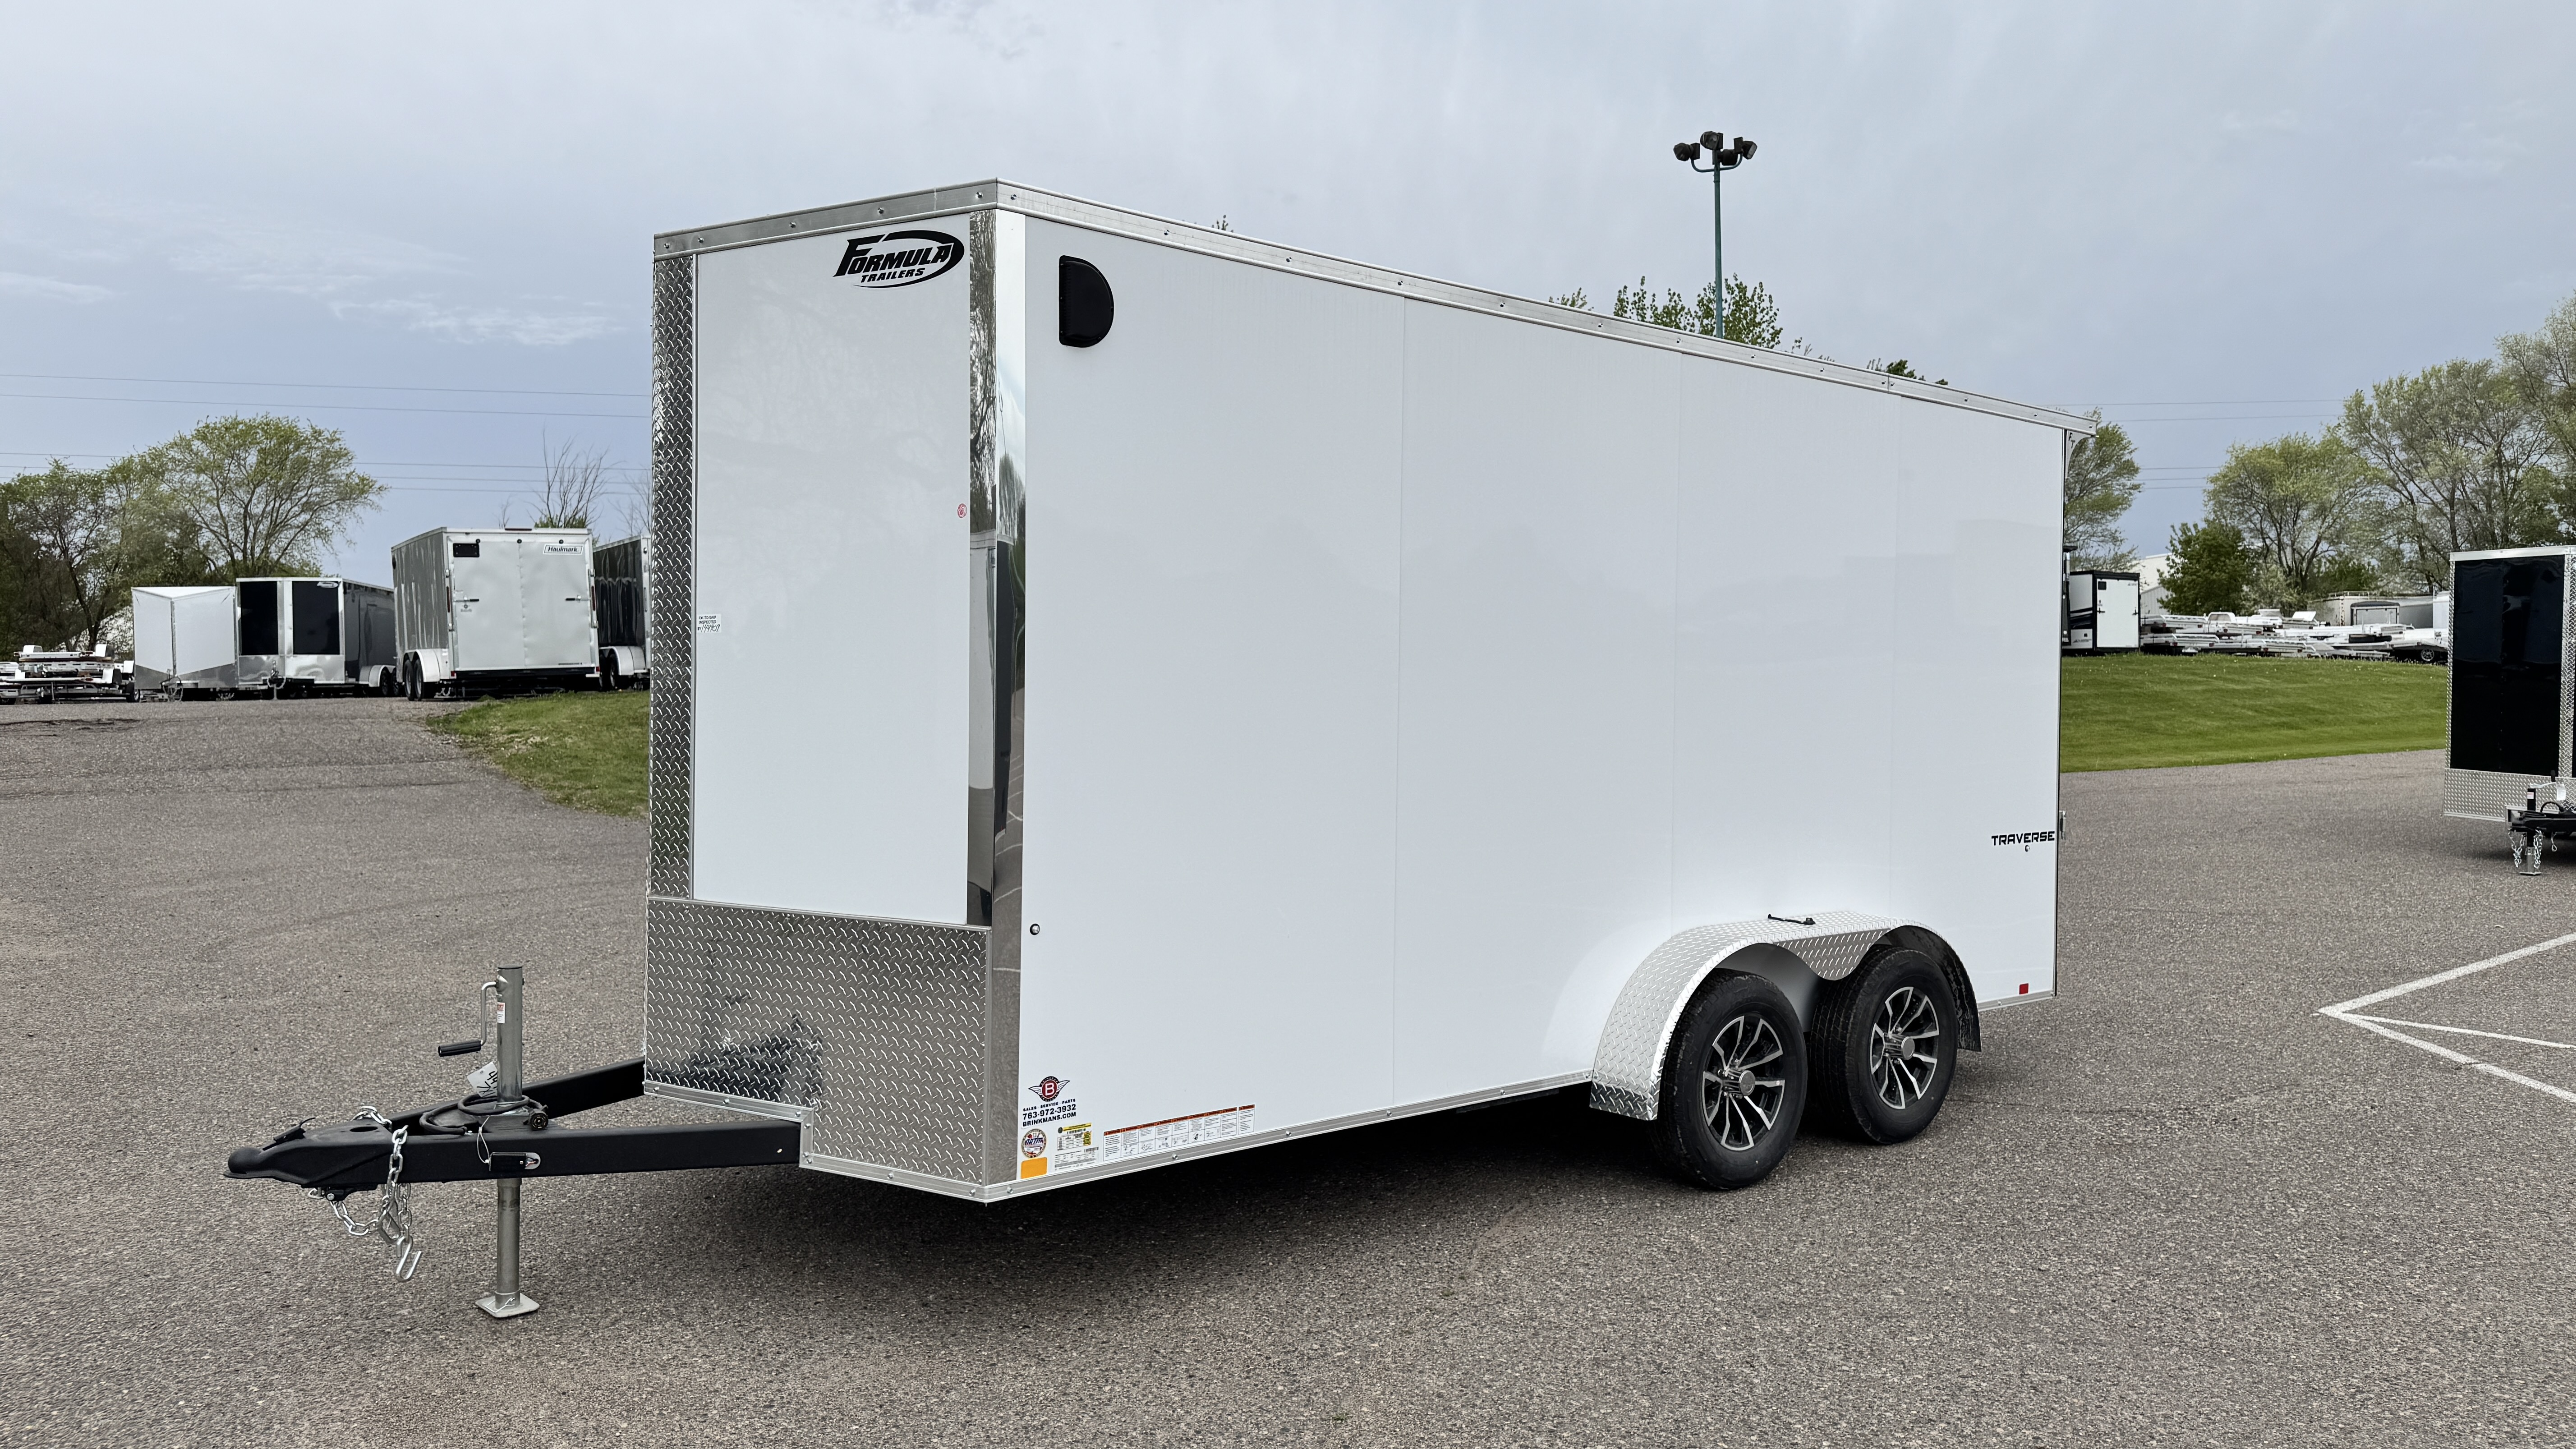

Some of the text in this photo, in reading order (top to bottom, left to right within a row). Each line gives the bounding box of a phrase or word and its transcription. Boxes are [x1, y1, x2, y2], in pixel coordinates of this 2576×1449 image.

[833, 234, 952, 277] FORMULA
[861, 268, 925, 283] TRAILERS
[1991, 831, 2055, 846] TRAVERSE
[1045, 1083, 1055, 1096] B
[1023, 1112, 1076, 1127] BRINKMANS.COM
